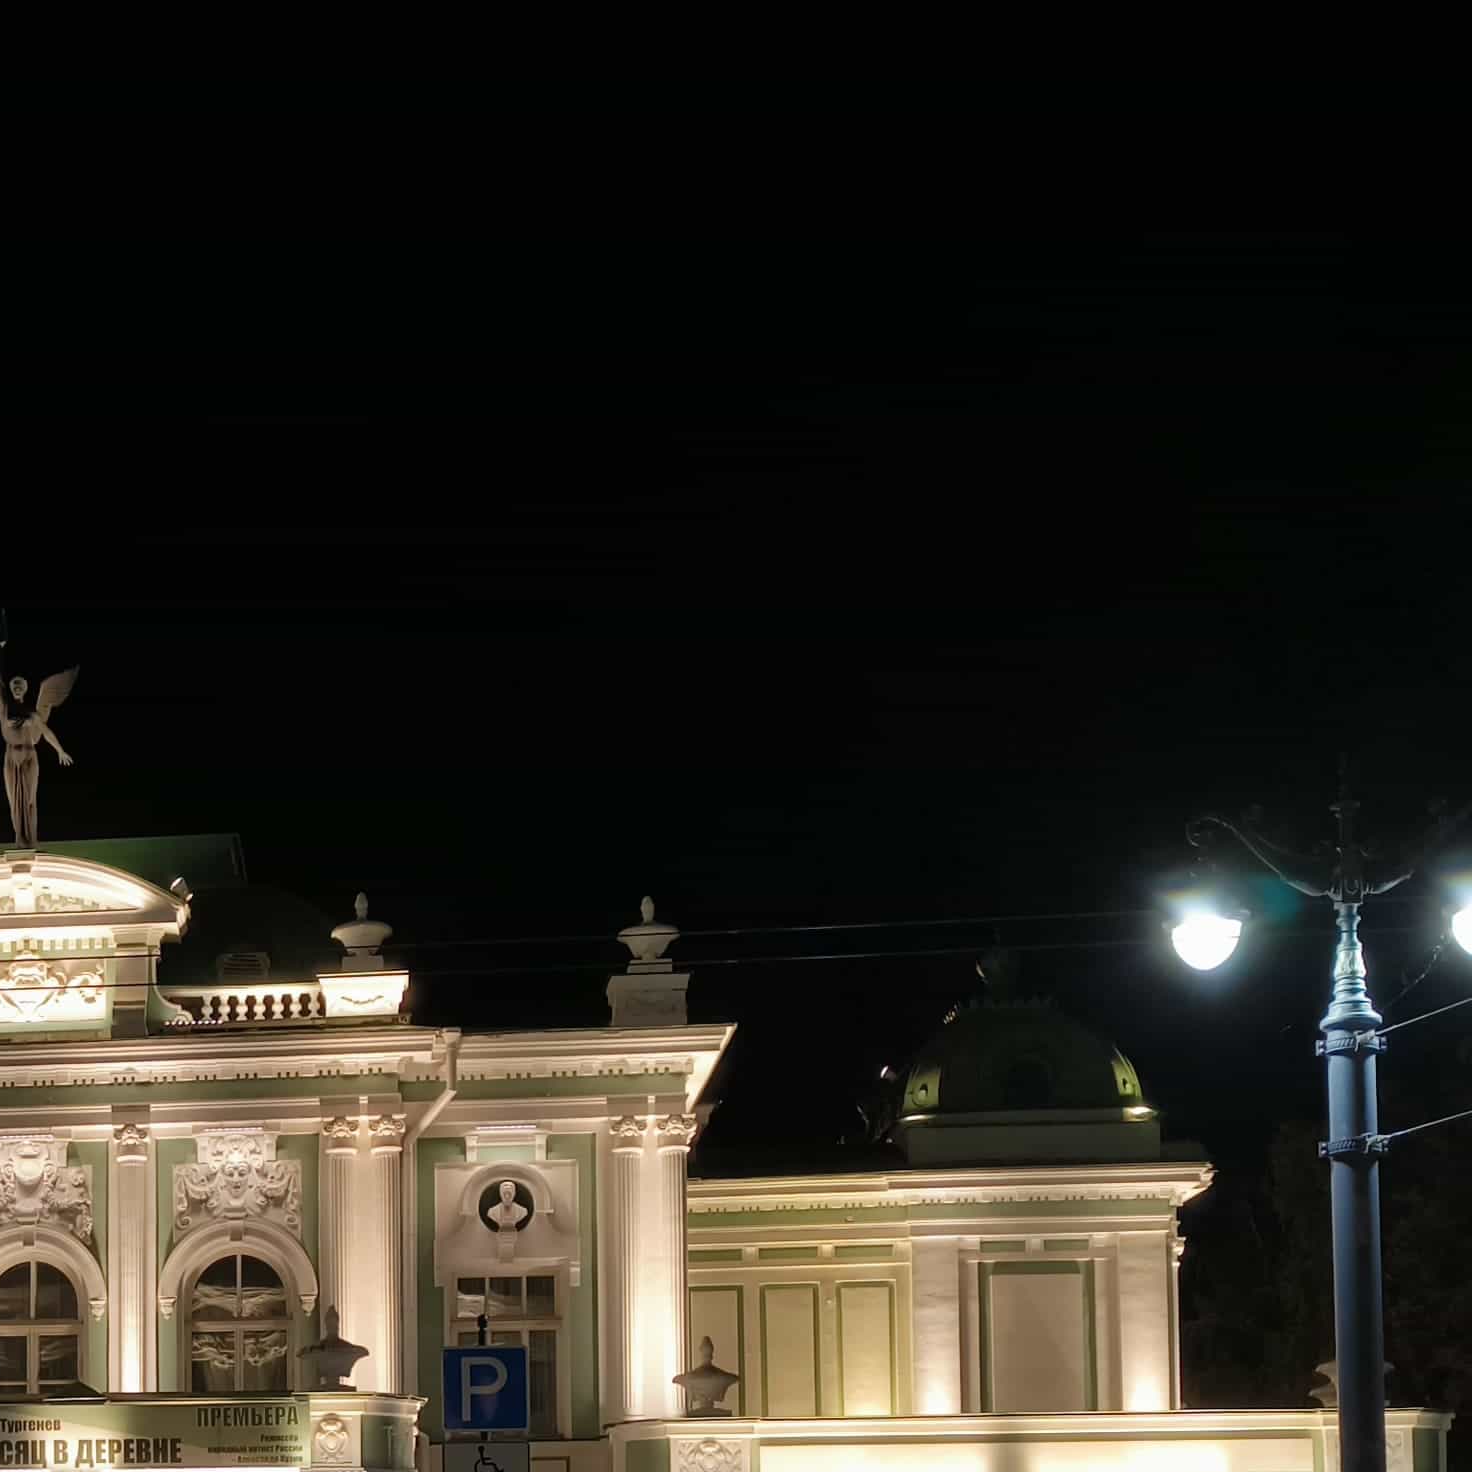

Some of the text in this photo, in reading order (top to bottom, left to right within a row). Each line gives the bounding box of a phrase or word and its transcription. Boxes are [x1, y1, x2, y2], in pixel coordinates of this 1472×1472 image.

[0, 1418, 61, 1433] Тургенев
[196, 1406, 299, 1427] ПРЕМЬЕРА
[53, 1439, 68, 1464] В
[75, 1438, 182, 1468] ДЕРЕВНЕ
